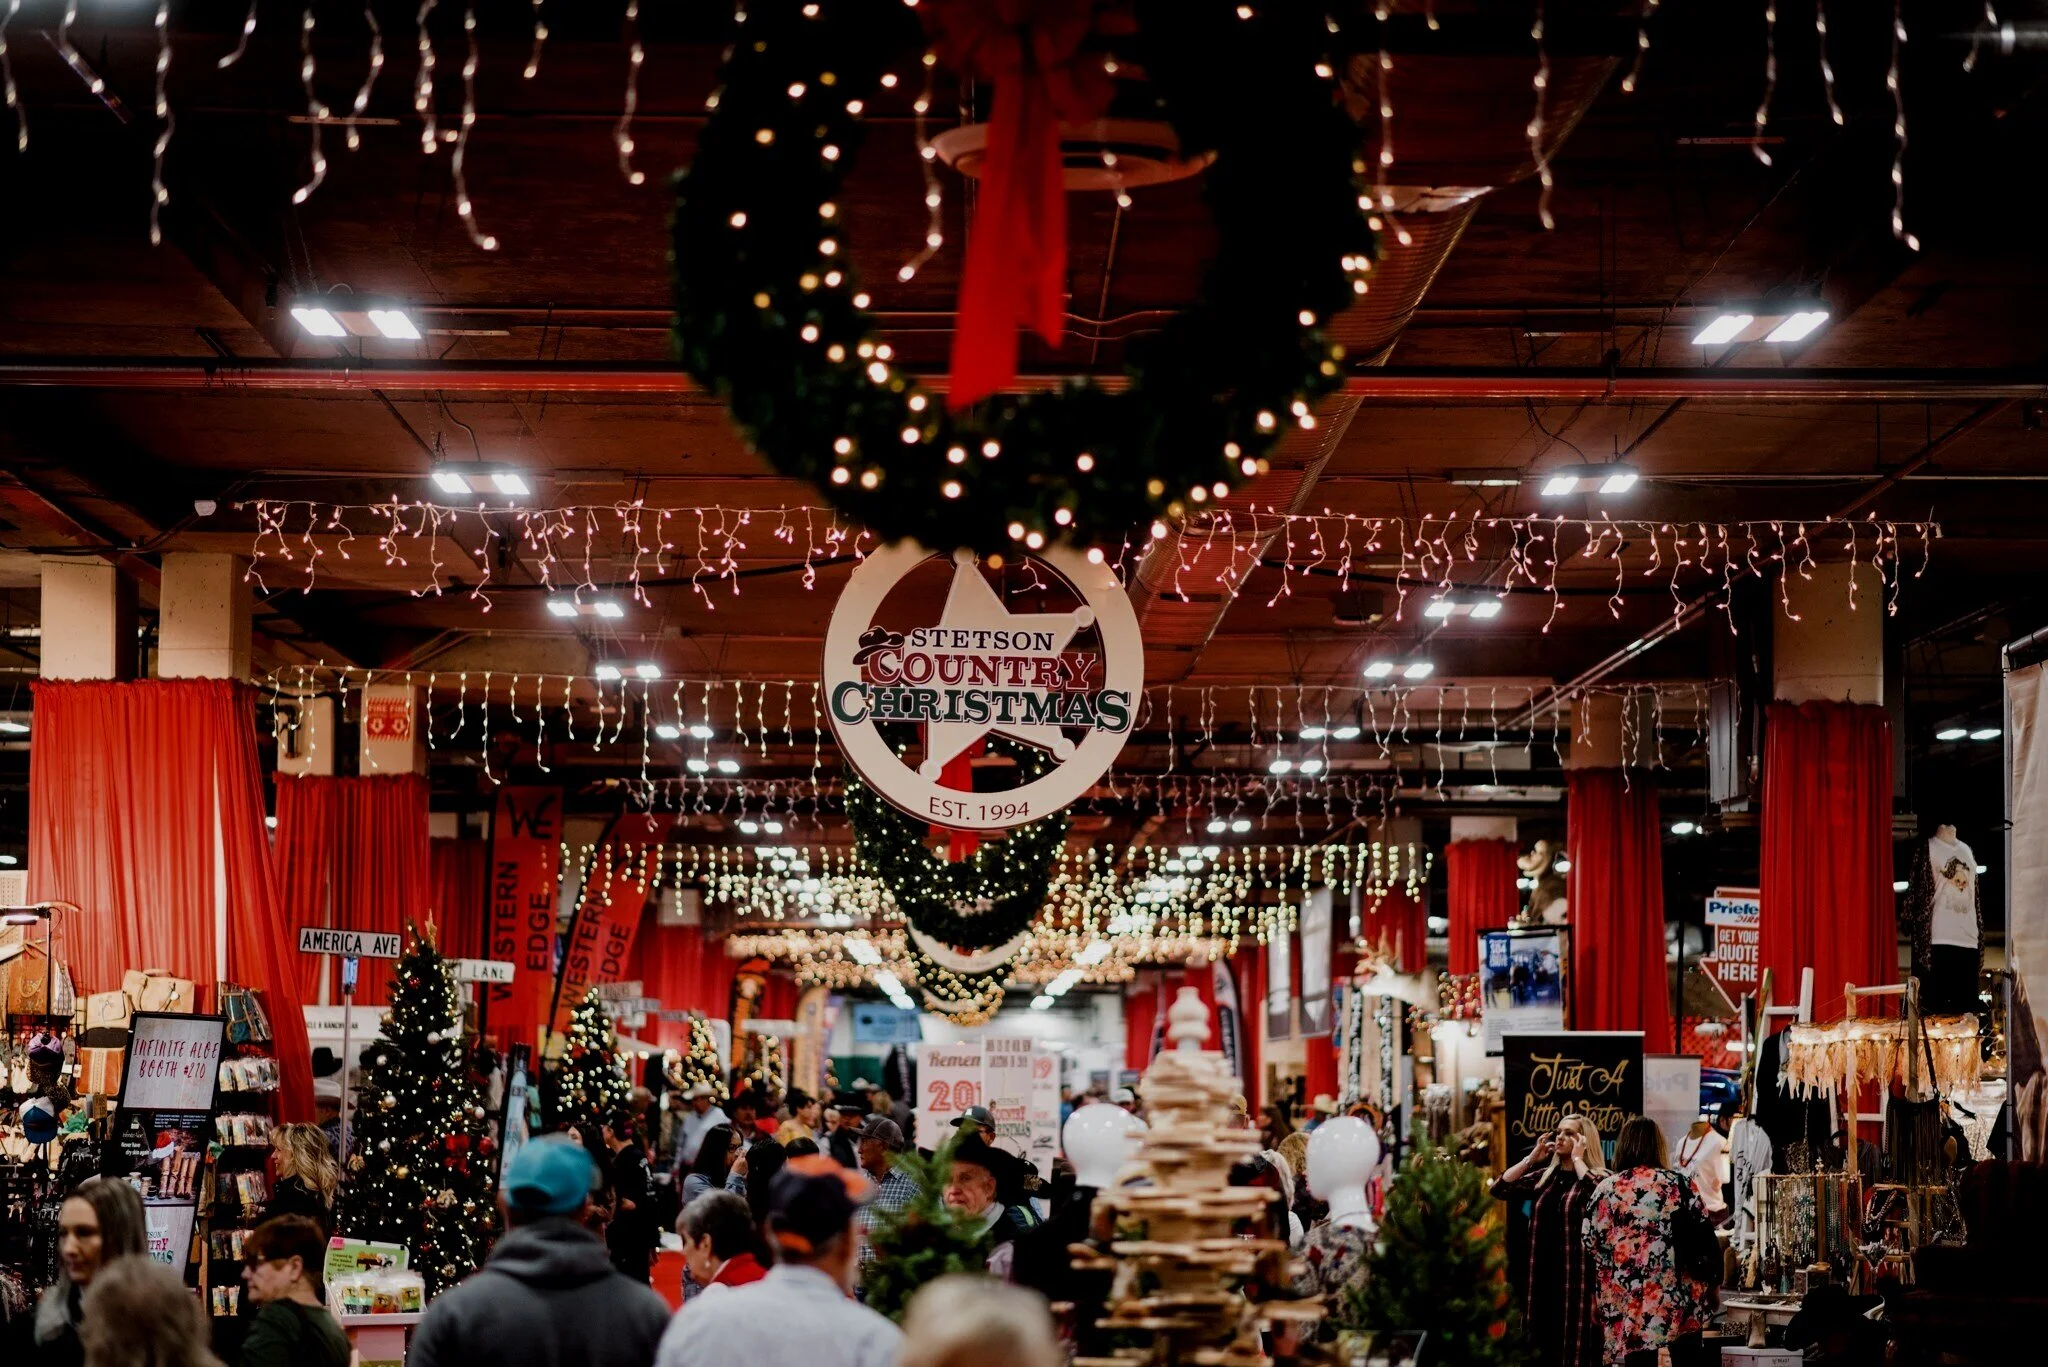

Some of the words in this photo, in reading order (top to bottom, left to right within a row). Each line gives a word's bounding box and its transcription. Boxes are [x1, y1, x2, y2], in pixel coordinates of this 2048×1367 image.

[911, 628, 1055, 650] STETSON
[868, 650, 1096, 690] COUNTRY
[832, 681, 1130, 732] CHRISTMAS
[929, 796, 970, 821] EST.
[979, 801, 1029, 821] 1994
[1709, 901, 1759, 915] Priefe
[302, 931, 362, 953] AMERICA
[373, 936, 398, 955] AVE
[492, 861, 518, 1001] WSTERN
[526, 893, 550, 971] EDGE
[1719, 928, 1737, 943] GET
[1719, 944, 1759, 963] QUOTE
[1717, 962, 1758, 982] HERE
[133, 1038, 186, 1057] INFINITE
[189, 1041, 219, 1059] ALOE
[139, 1059, 177, 1078] BOOTH
[1530, 1053, 1594, 1099] Just
[1589, 1059, 1629, 1096] A
[1511, 1093, 1561, 1138] Little
